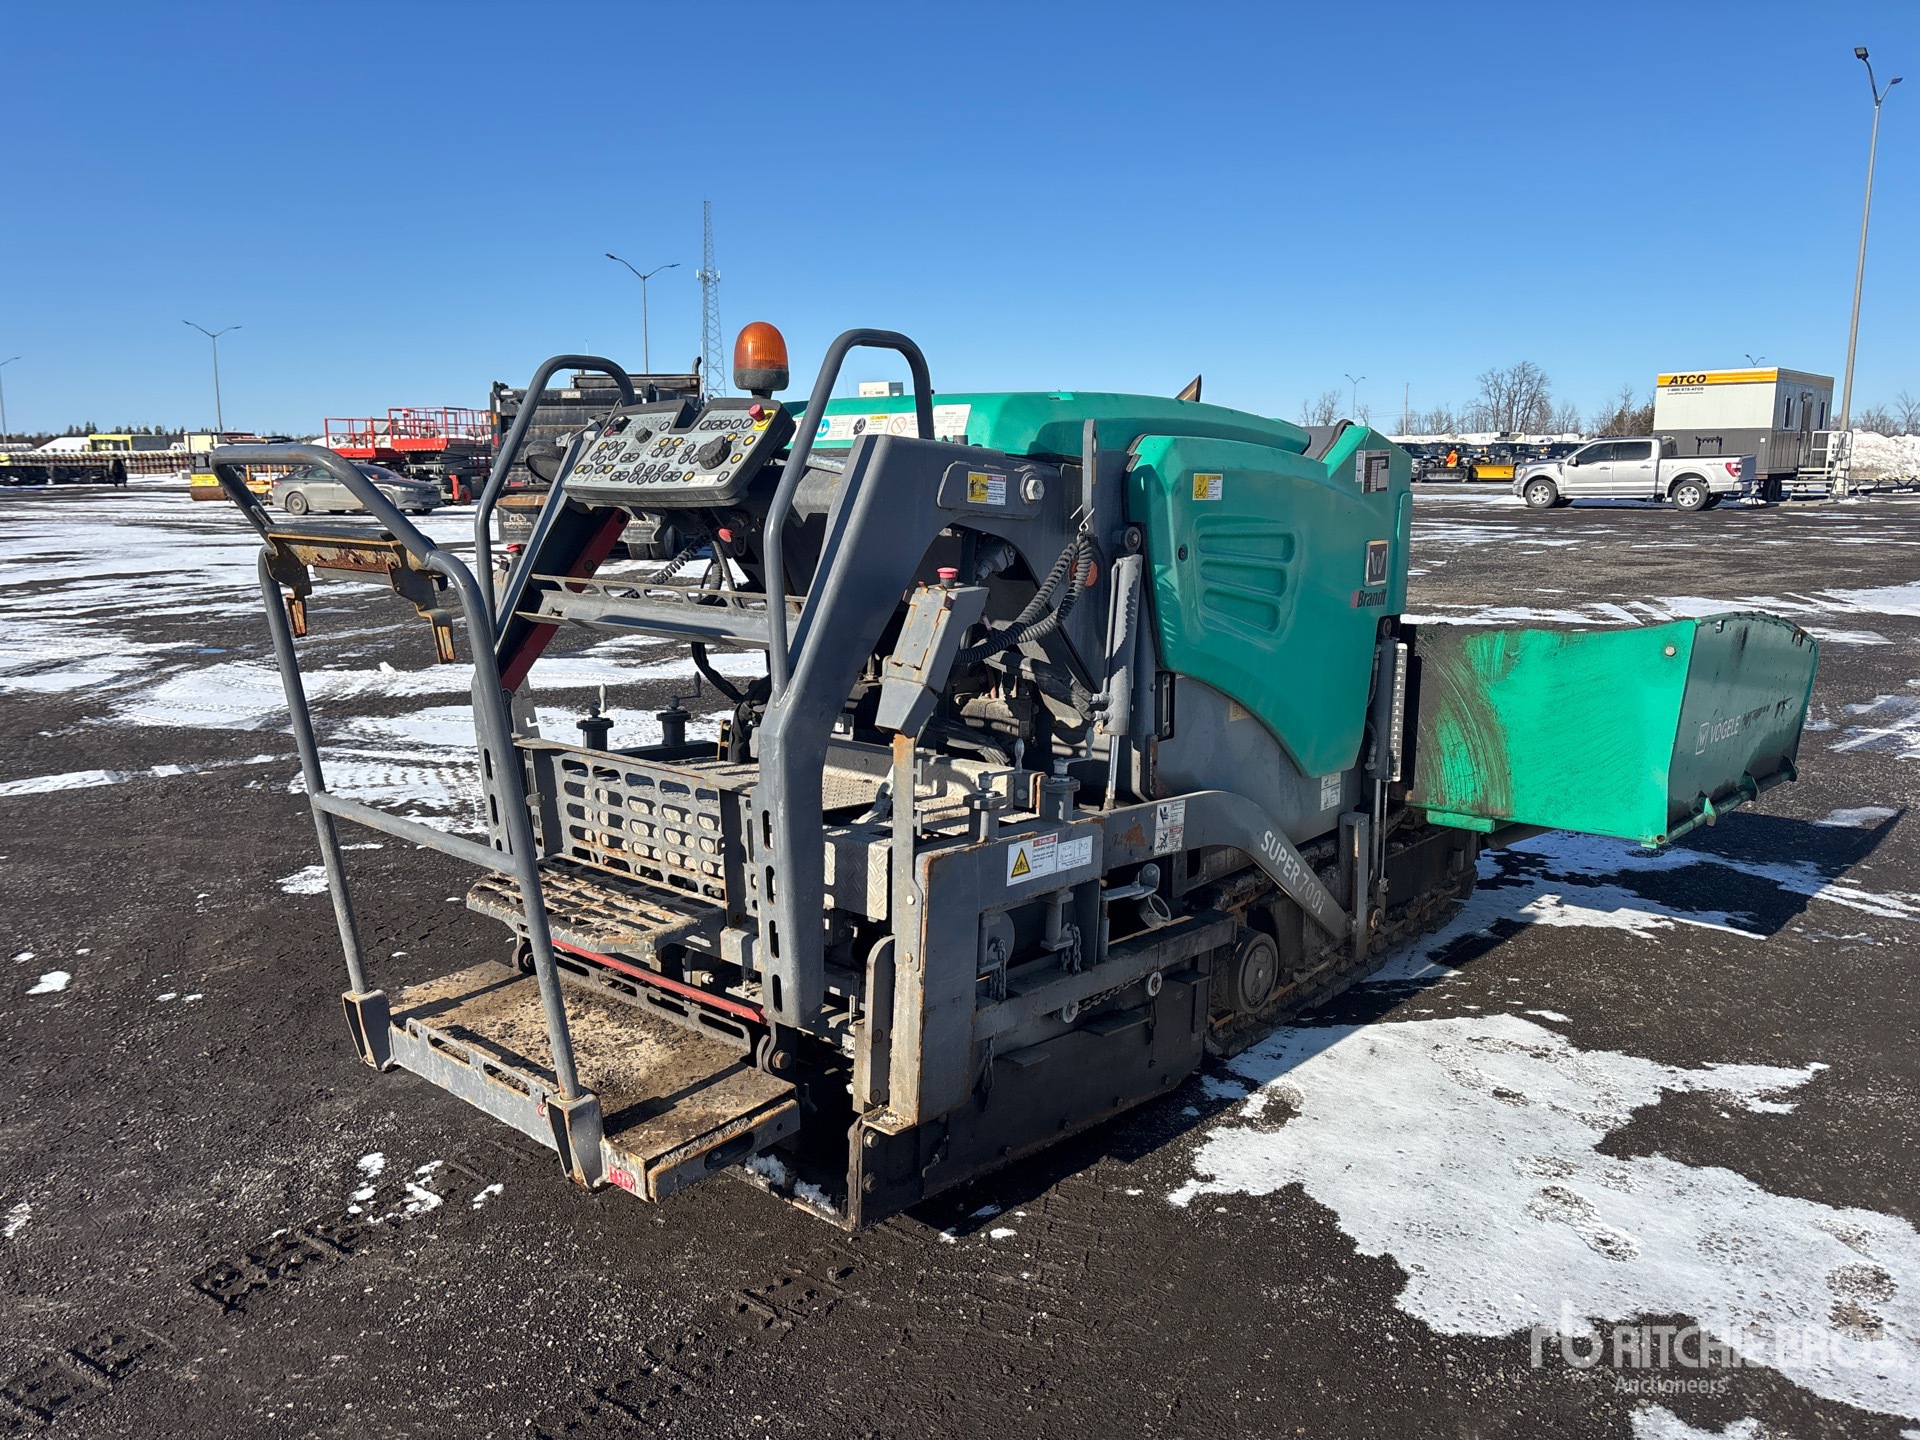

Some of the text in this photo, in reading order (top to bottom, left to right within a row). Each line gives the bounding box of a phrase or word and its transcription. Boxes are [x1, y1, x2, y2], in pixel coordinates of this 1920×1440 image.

[1669, 374, 1707, 385] ATCO
[1357, 589, 1387, 608] Brandt
[1260, 830, 1301, 886] SUPER
